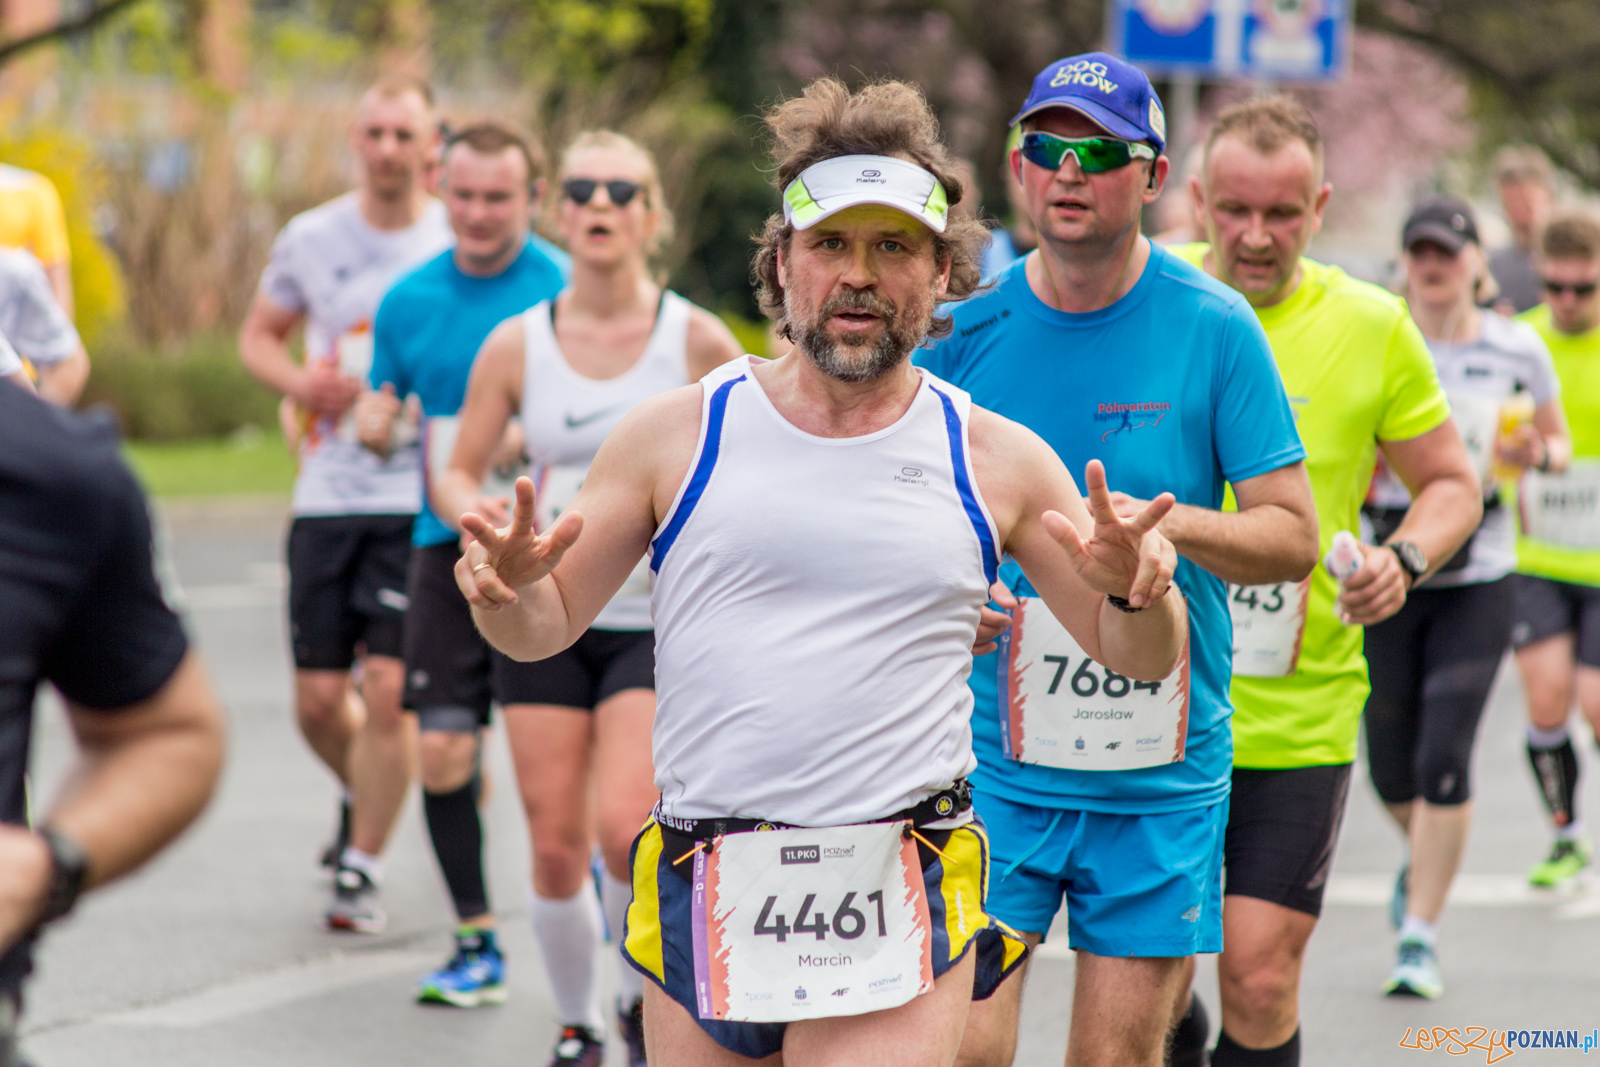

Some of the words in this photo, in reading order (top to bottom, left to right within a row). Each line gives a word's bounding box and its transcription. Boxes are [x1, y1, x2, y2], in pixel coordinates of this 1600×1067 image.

[1056, 60, 1108, 78] DOG
[1049, 71, 1119, 95] CHOW
[856, 177, 887, 185] Kalenji
[1098, 401, 1171, 414] Półmaraton
[893, 475, 929, 487] Kalenji
[1226, 583, 1285, 612] 43
[1072, 707, 1134, 720] Jarosław
[753, 889, 888, 943] 4461
[798, 953, 853, 967] Marcin
[831, 988, 850, 997] 4F
